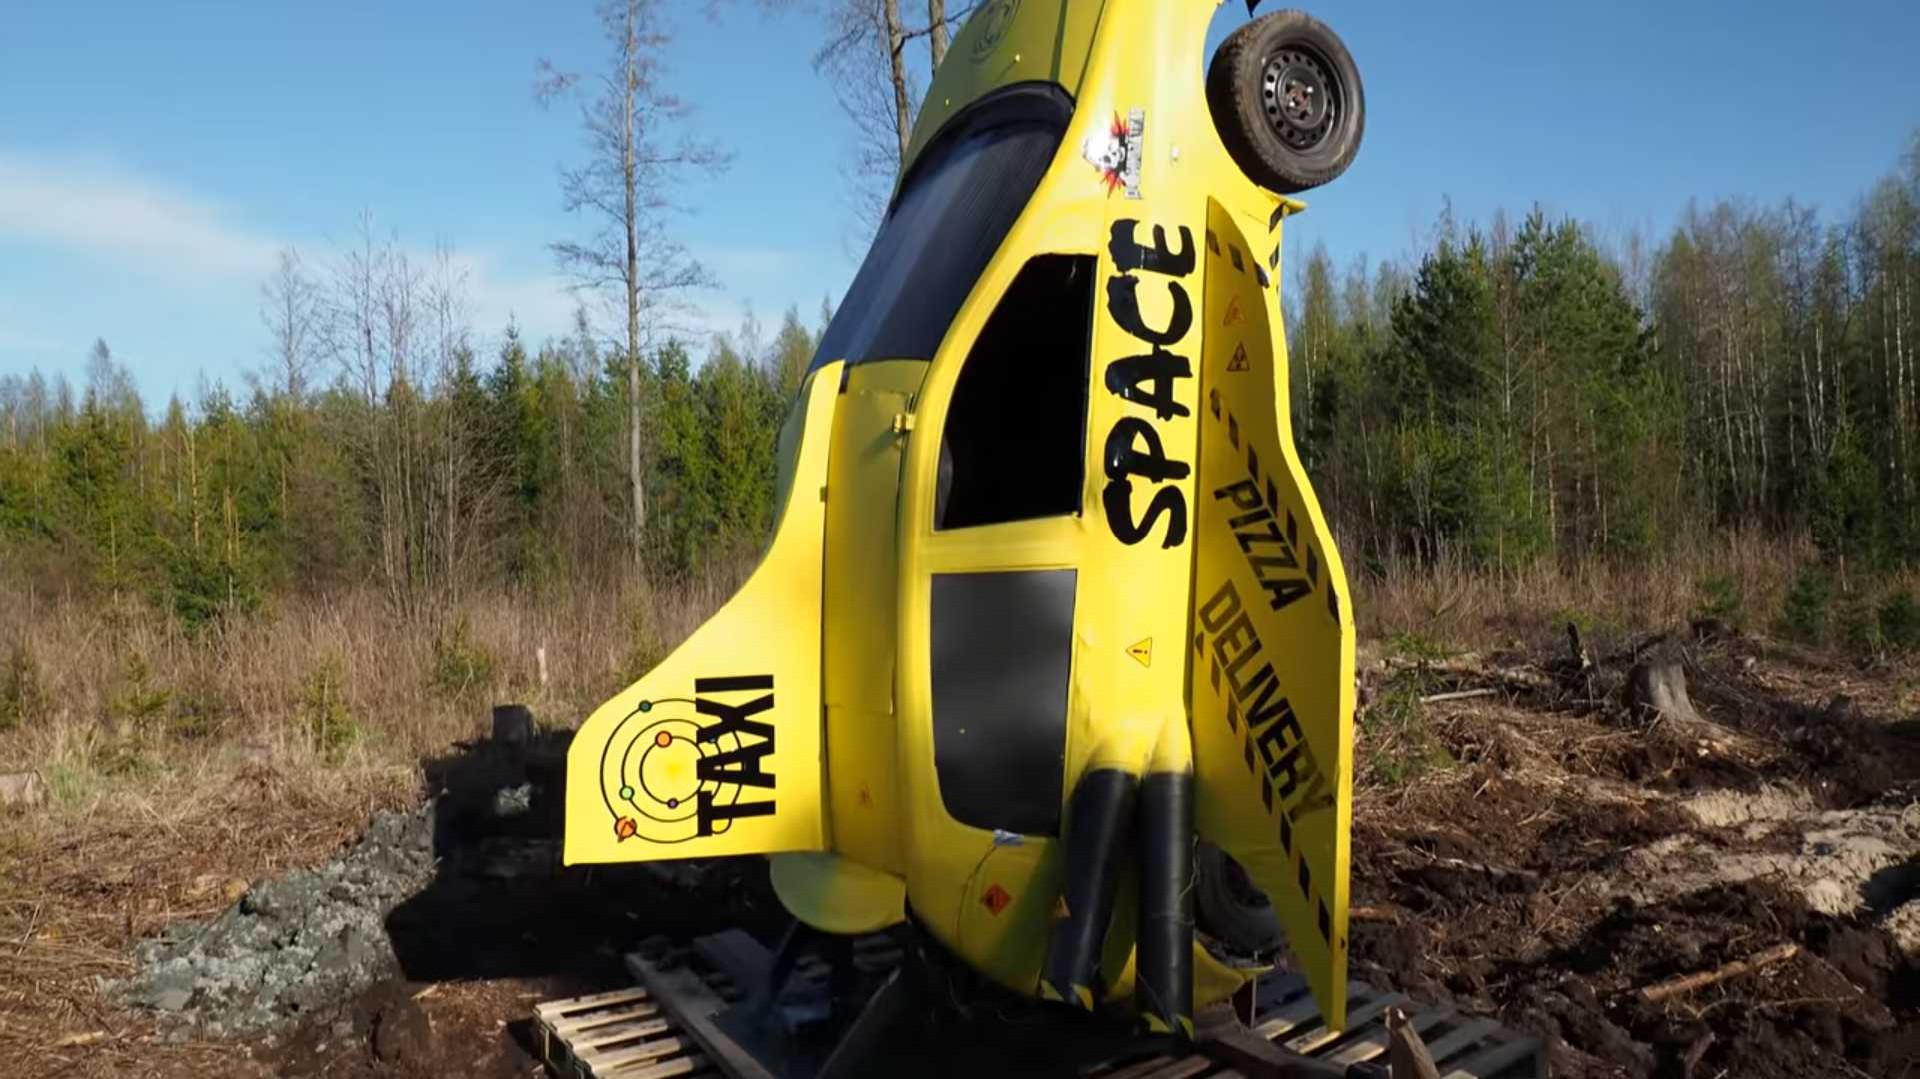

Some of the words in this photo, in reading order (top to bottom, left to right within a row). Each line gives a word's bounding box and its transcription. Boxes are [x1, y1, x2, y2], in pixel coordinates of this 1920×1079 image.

[1102, 218, 1196, 549] SPACE
[1213, 479, 1312, 612] PIZZA
[694, 674, 776, 837] TAXI
[1198, 578, 1337, 826] DELIVERY
